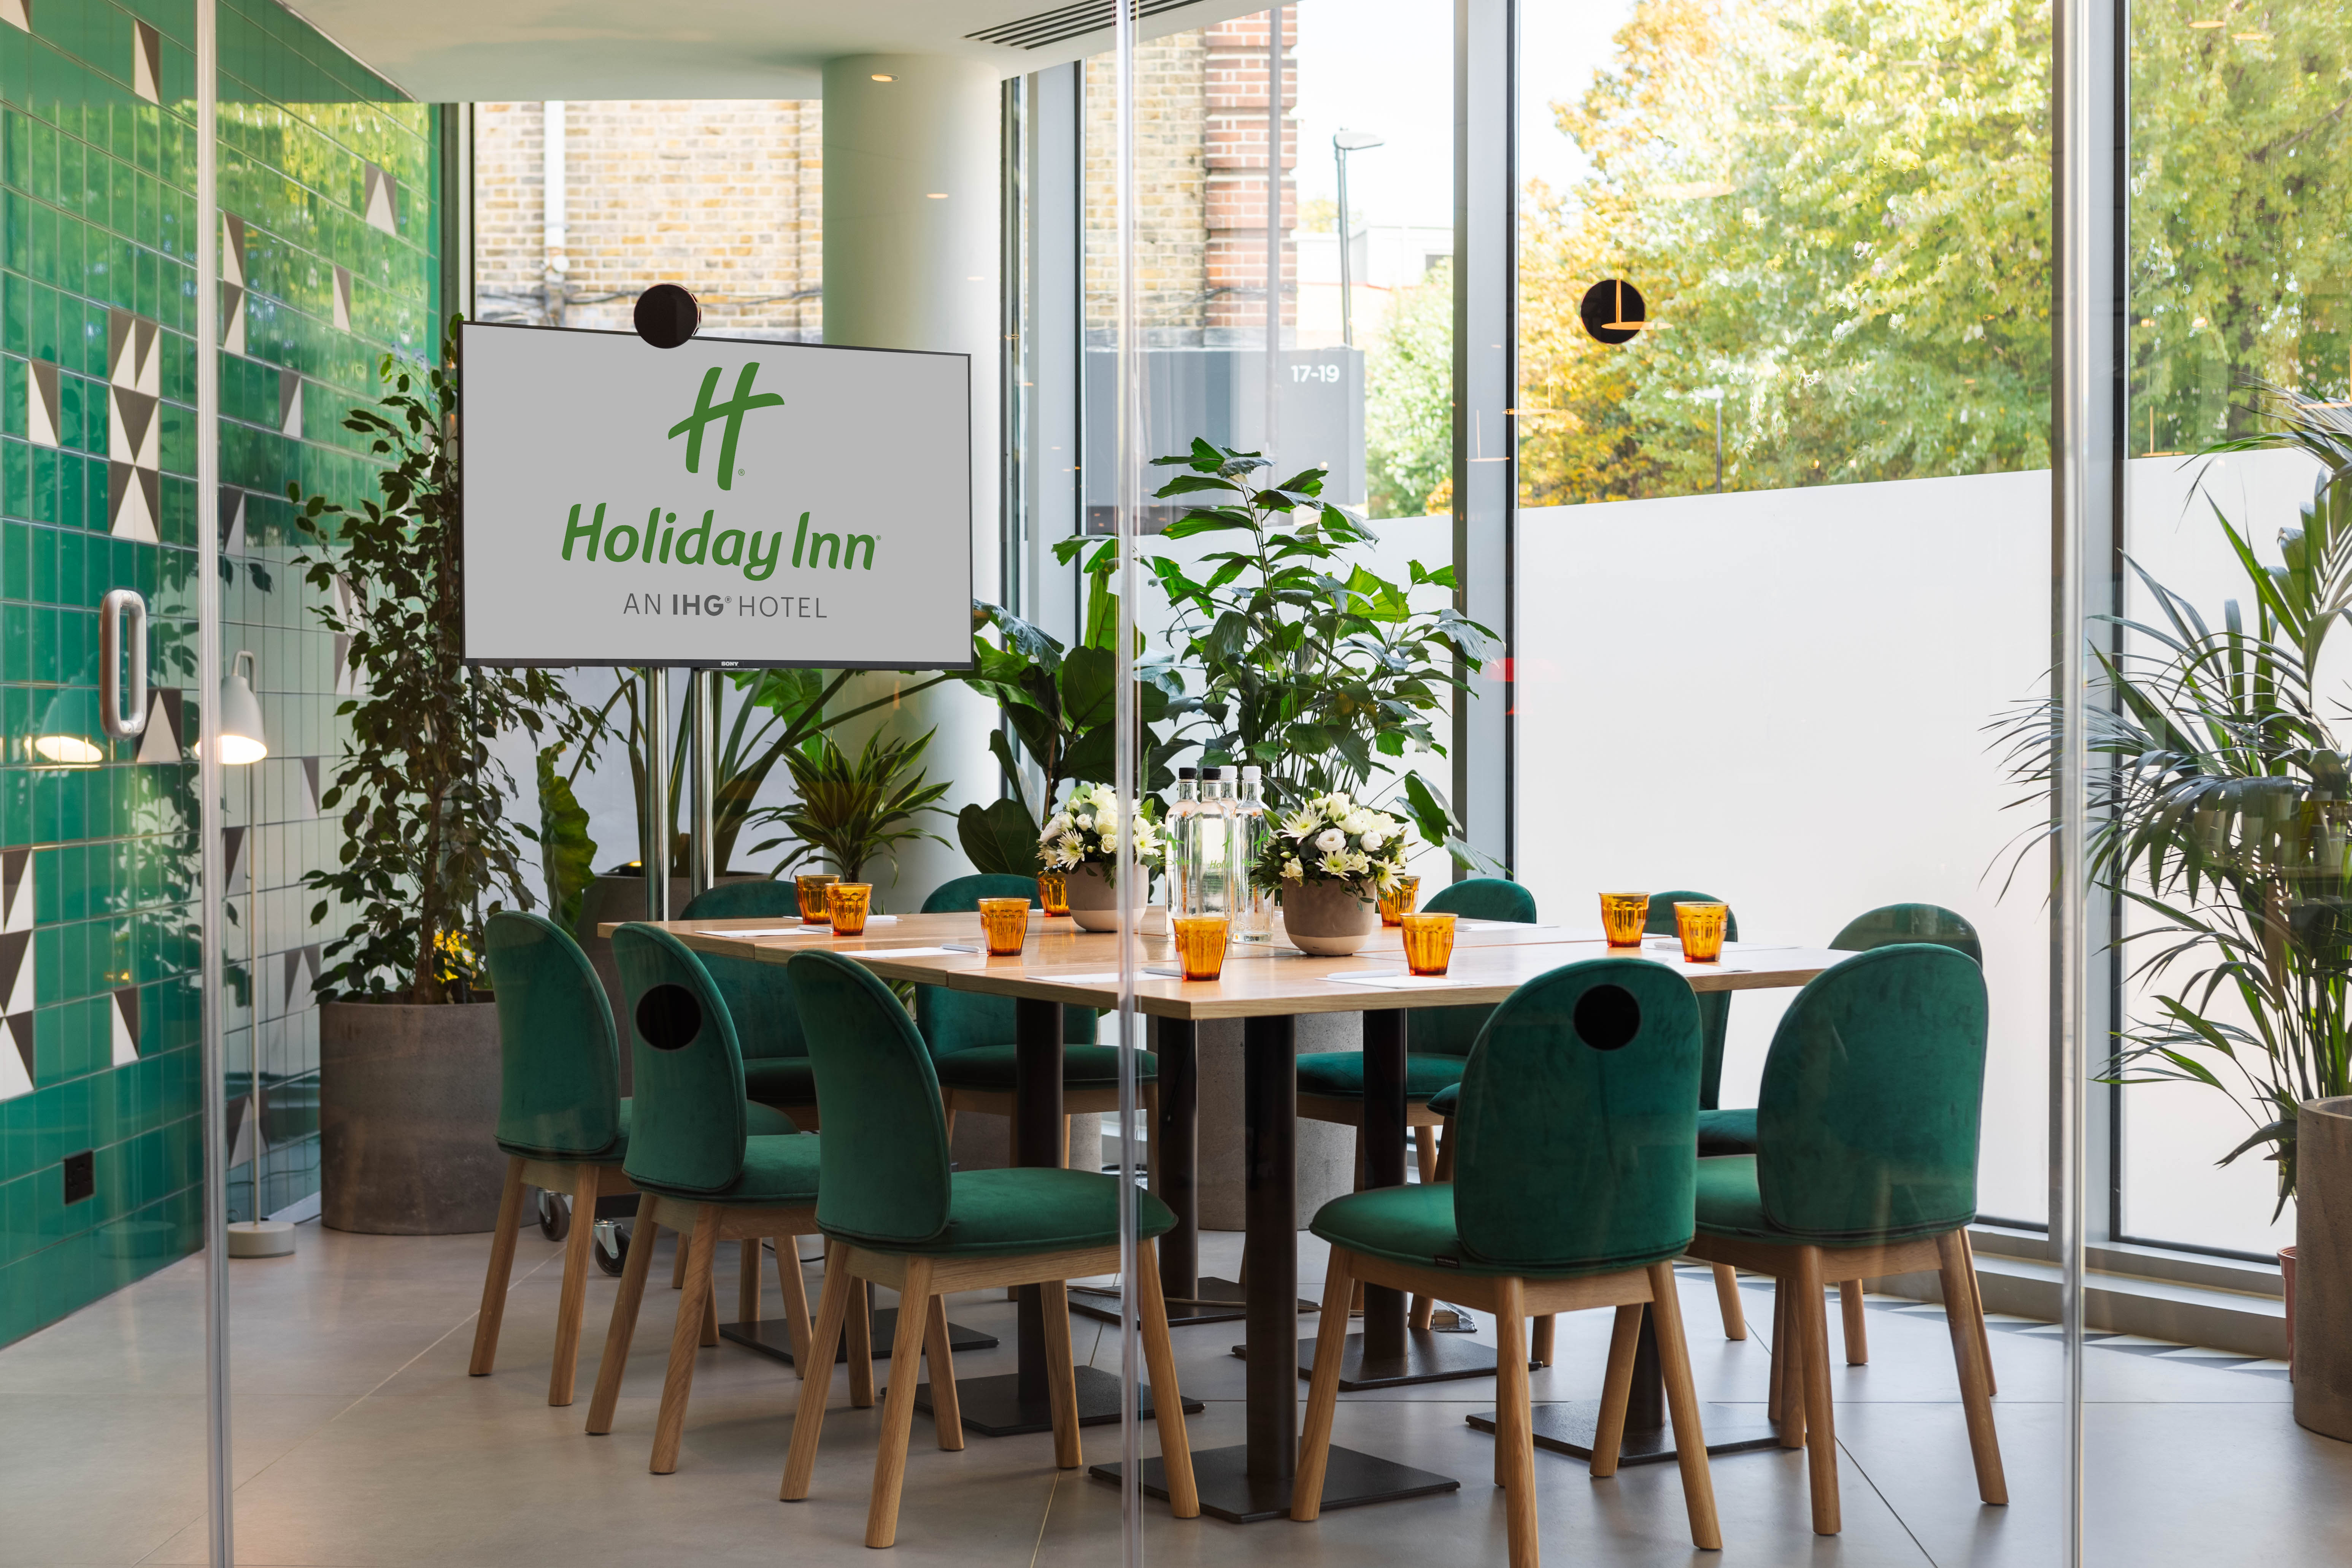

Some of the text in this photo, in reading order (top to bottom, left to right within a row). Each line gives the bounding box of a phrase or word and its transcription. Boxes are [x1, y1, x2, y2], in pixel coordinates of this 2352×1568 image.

[1291, 364, 1340, 382] 17-19
[562, 502, 783, 581] Holiday
[623, 593, 661, 615] AN
[739, 596, 827, 618] HOTEL
